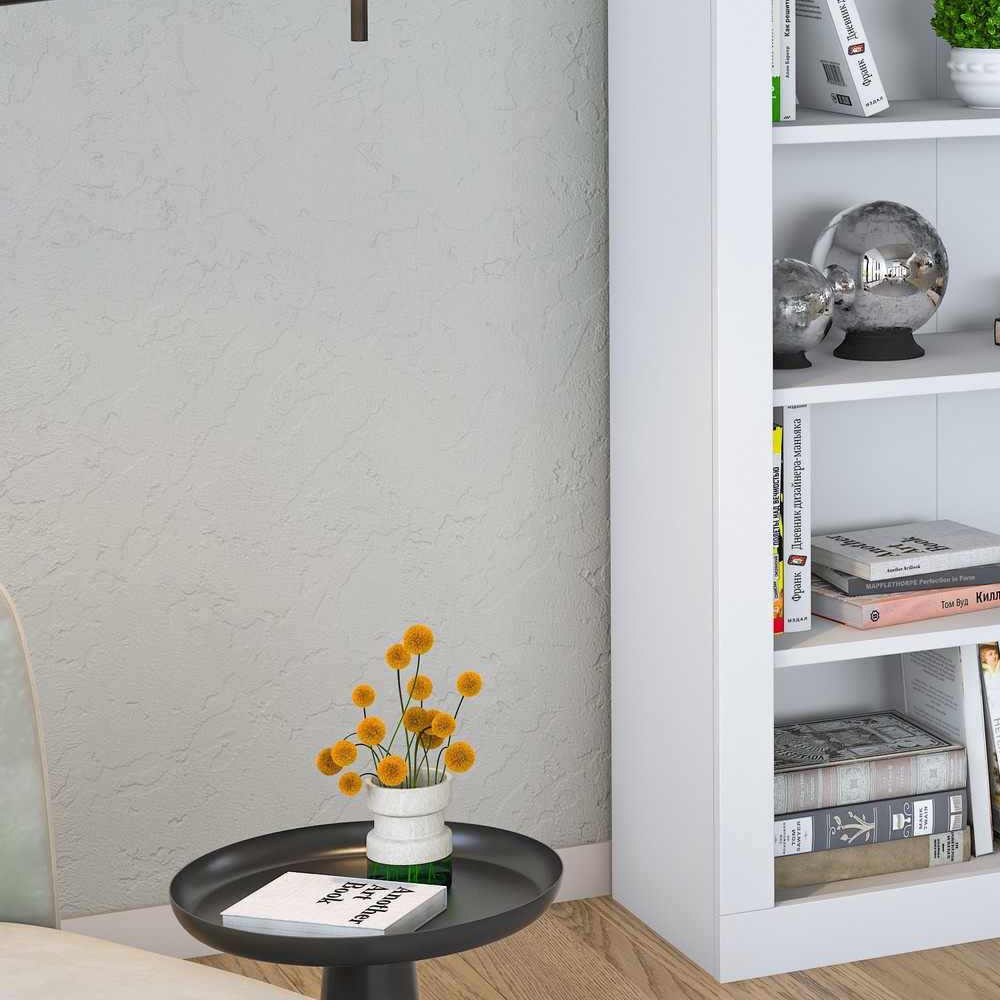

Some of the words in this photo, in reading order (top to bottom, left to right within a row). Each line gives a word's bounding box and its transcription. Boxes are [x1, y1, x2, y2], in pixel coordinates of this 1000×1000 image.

[838, 3, 858, 41] Дневник
[858, 58, 872, 86] Франк
[791, 418, 804, 509] дизайнера-маньяка
[790, 510, 803, 550] Дневник
[826, 535, 900, 558] Another
[886, 543, 927, 554] Art
[900, 536, 950, 552] Book
[792, 572, 802, 602] Франк
[866, 579, 918, 590] MAPPLETHORPE
[919, 576, 952, 586] Perfection
[960, 574, 976, 582] Form
[941, 600, 954, 609] Том
[956, 598, 969, 608] Вуд
[316, 882, 368, 904] Book
[352, 884, 390, 900] Art
[348, 886, 415, 924] Another
